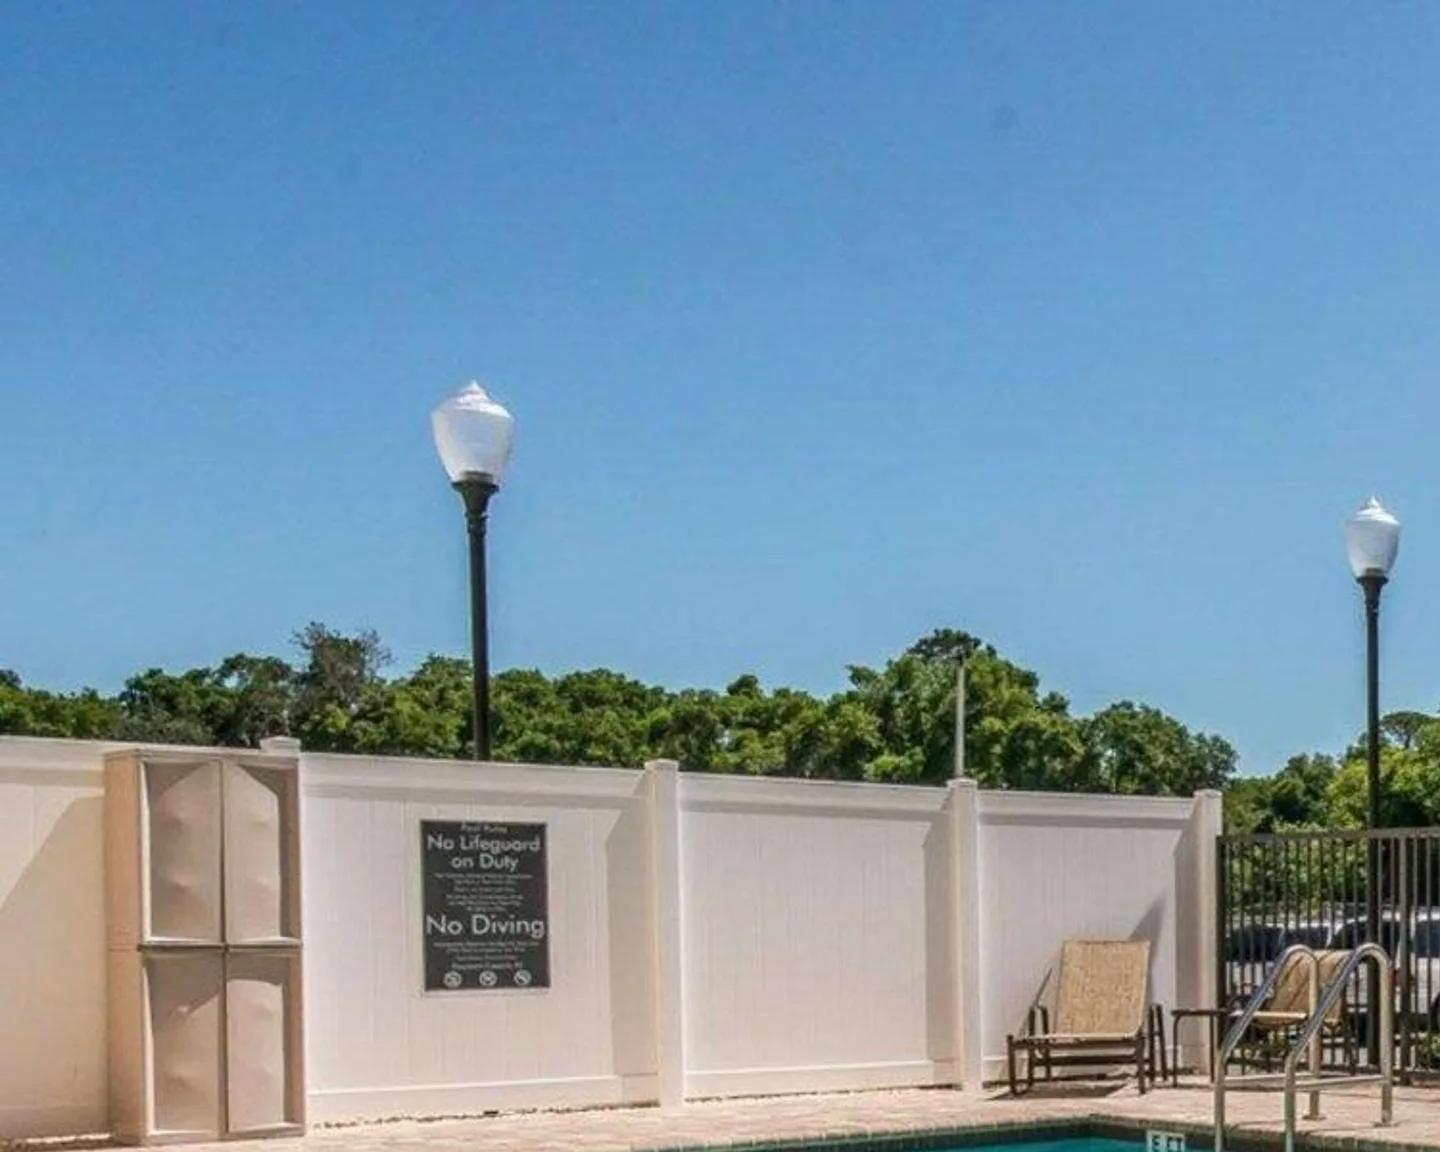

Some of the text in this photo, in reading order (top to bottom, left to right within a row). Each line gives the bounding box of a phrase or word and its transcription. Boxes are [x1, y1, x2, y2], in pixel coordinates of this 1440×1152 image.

[427, 834, 540, 855] No Lifeguard
[451, 853, 519, 873] on Duty
[426, 912, 546, 939] No Diving
